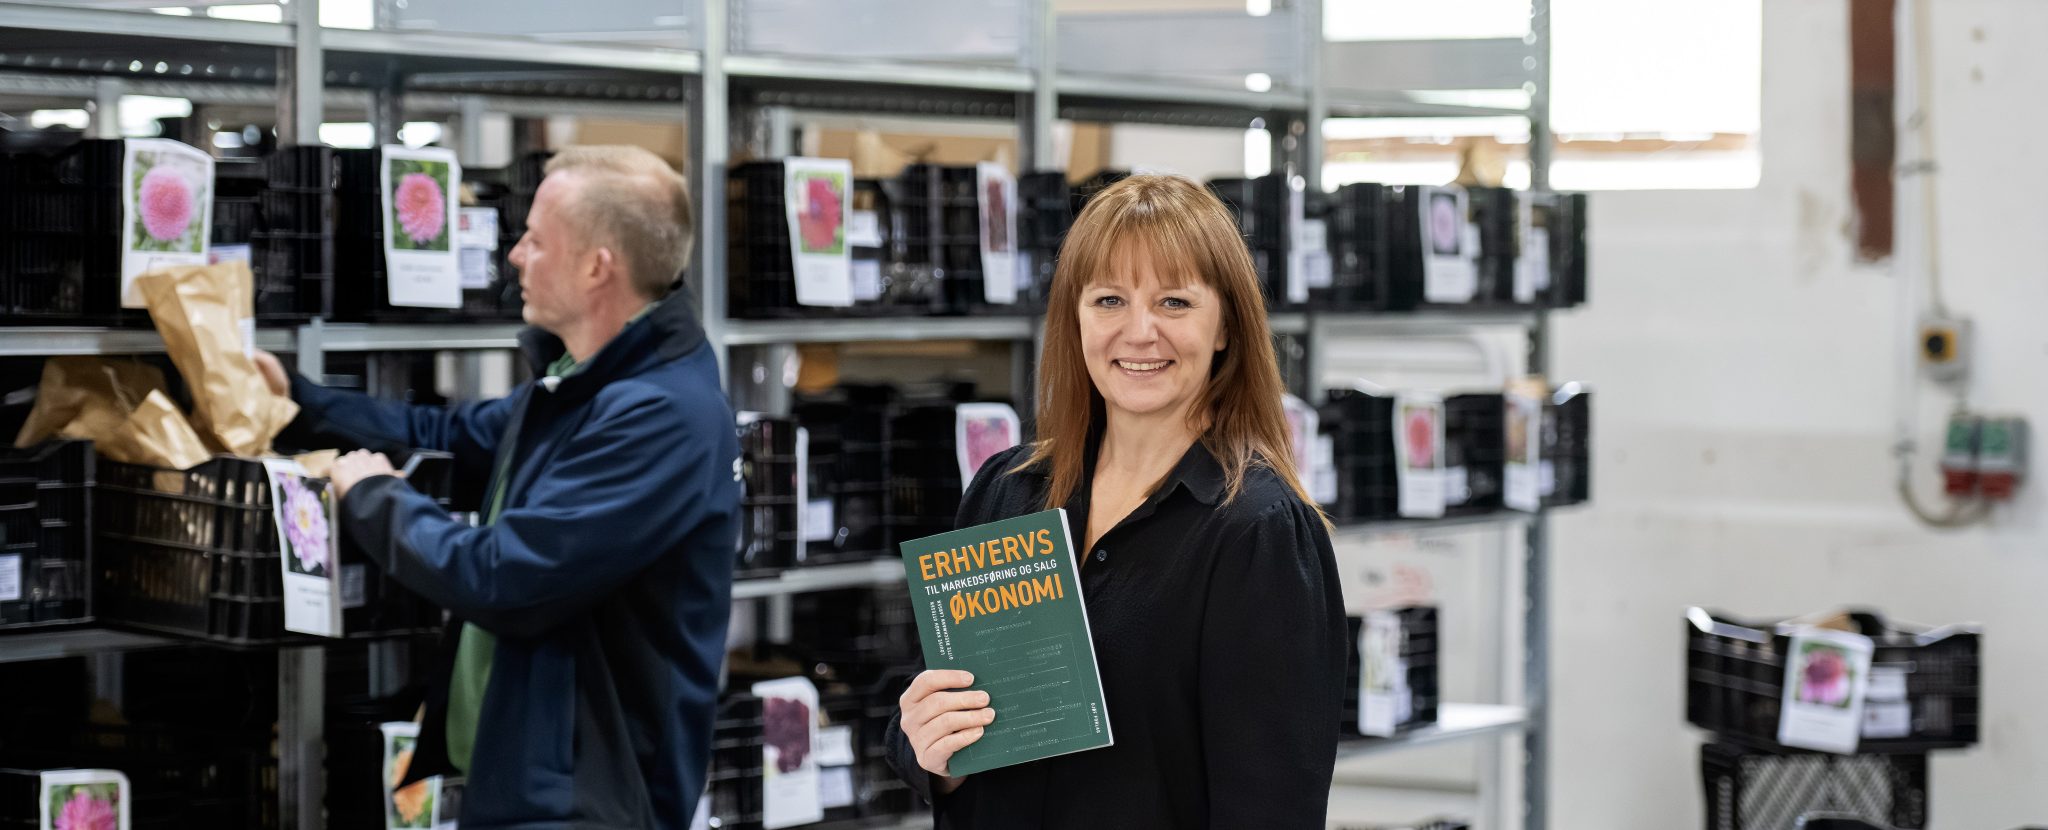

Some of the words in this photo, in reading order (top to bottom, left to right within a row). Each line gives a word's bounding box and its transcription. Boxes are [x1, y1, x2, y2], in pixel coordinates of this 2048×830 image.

[918, 529, 1054, 581] ERHVERVS
[925, 585, 940, 596] TIL
[941, 569, 1017, 592] MARKEDSFØRING
[1020, 565, 1032, 576] OG
[1034, 559, 1057, 573] SALG
[950, 573, 1064, 625] ØKONOMI
